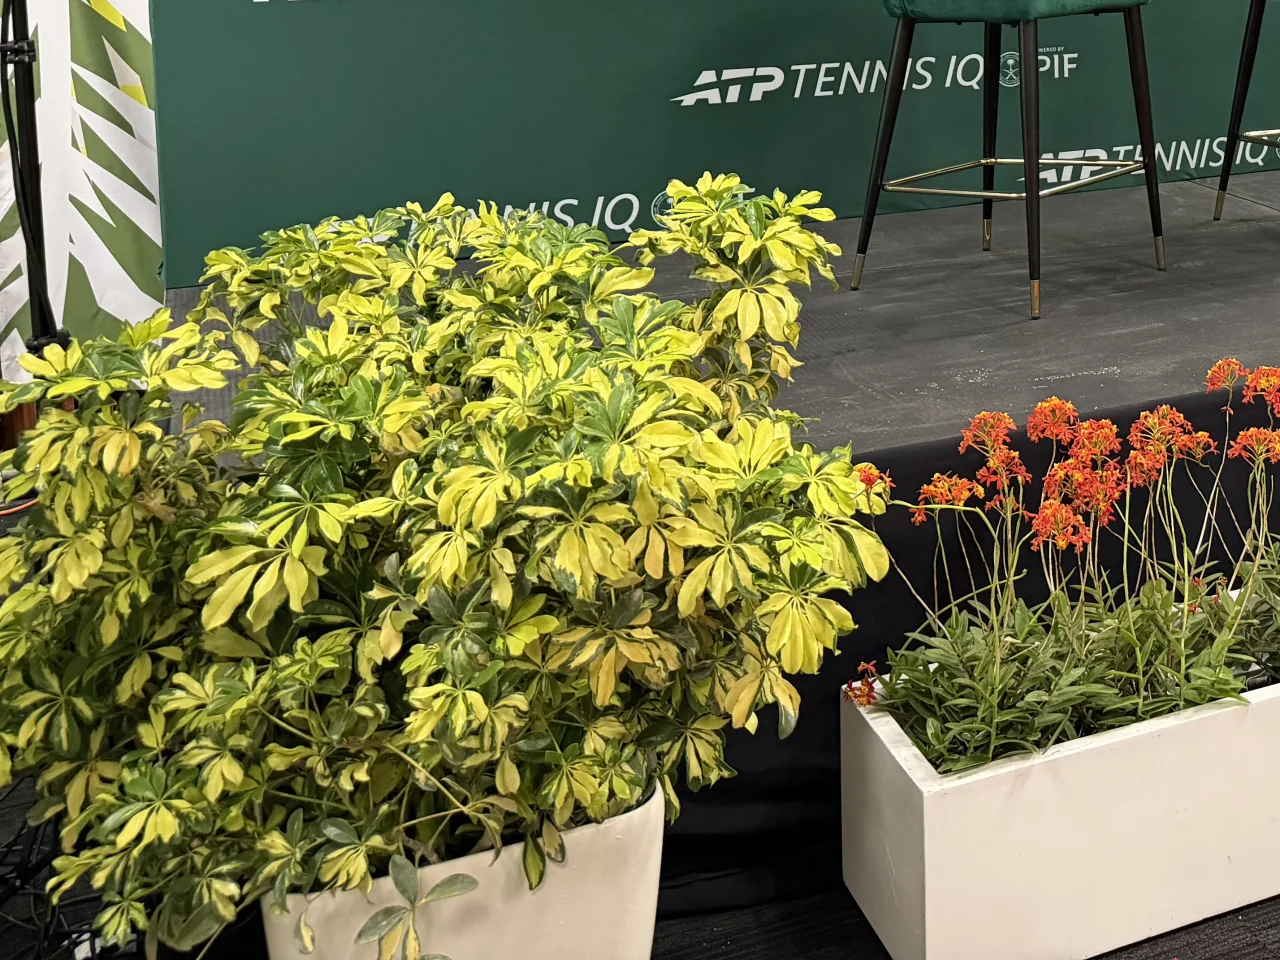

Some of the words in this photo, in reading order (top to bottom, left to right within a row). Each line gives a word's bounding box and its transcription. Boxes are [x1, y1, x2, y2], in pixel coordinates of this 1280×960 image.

[669, 66, 784, 106] ATP
[945, 53, 984, 90] IQ
[592, 193, 640, 233] IQ
